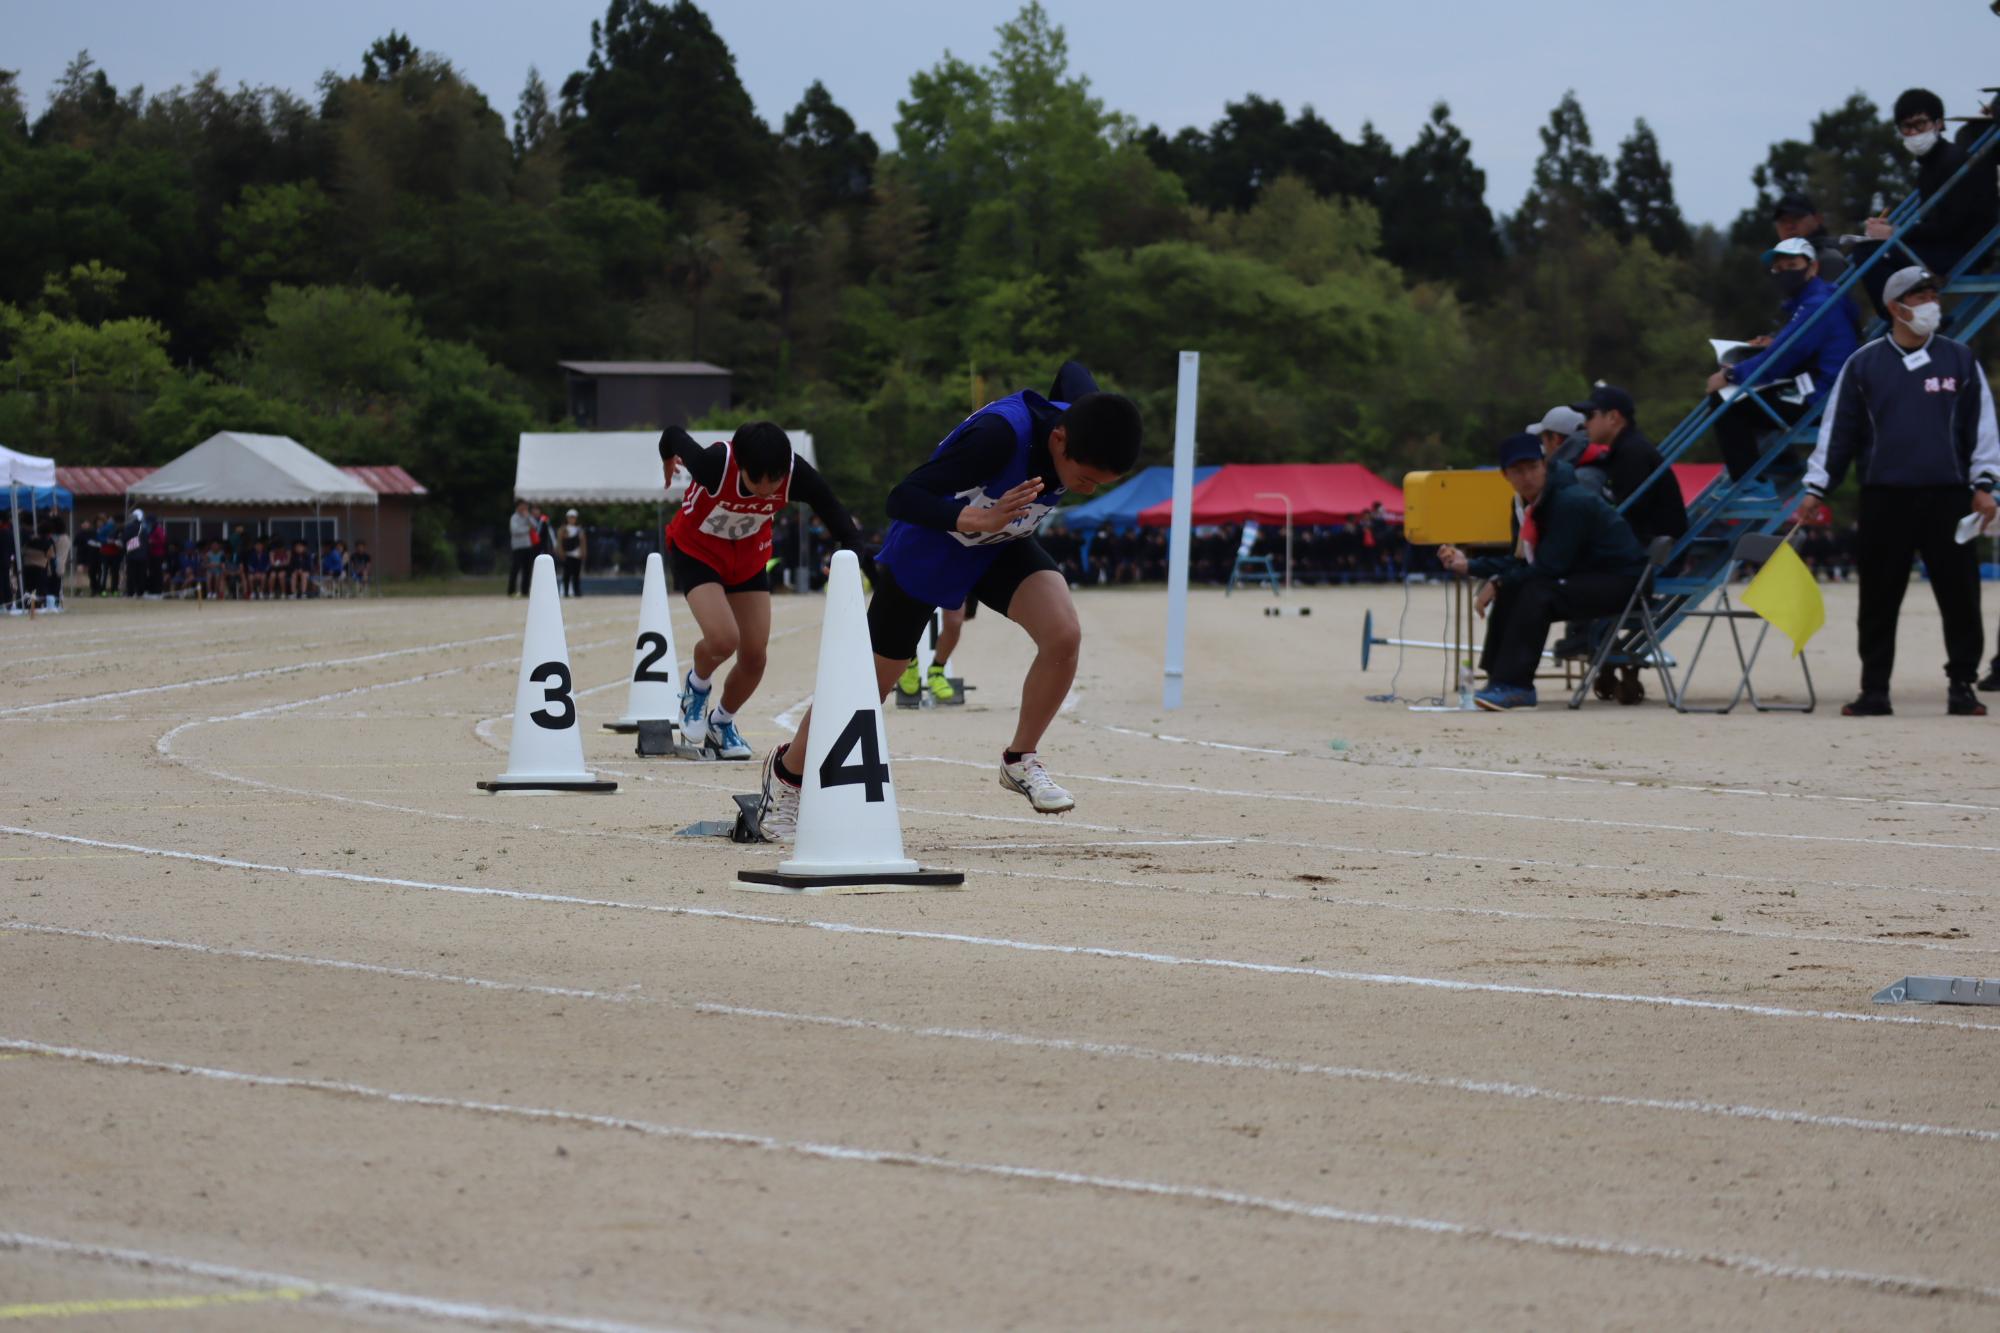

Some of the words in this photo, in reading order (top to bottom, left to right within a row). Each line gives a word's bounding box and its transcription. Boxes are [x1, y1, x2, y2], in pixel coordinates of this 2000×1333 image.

[633, 631, 669, 683] 2
[529, 661, 576, 730] 3
[819, 709, 890, 803] 4
